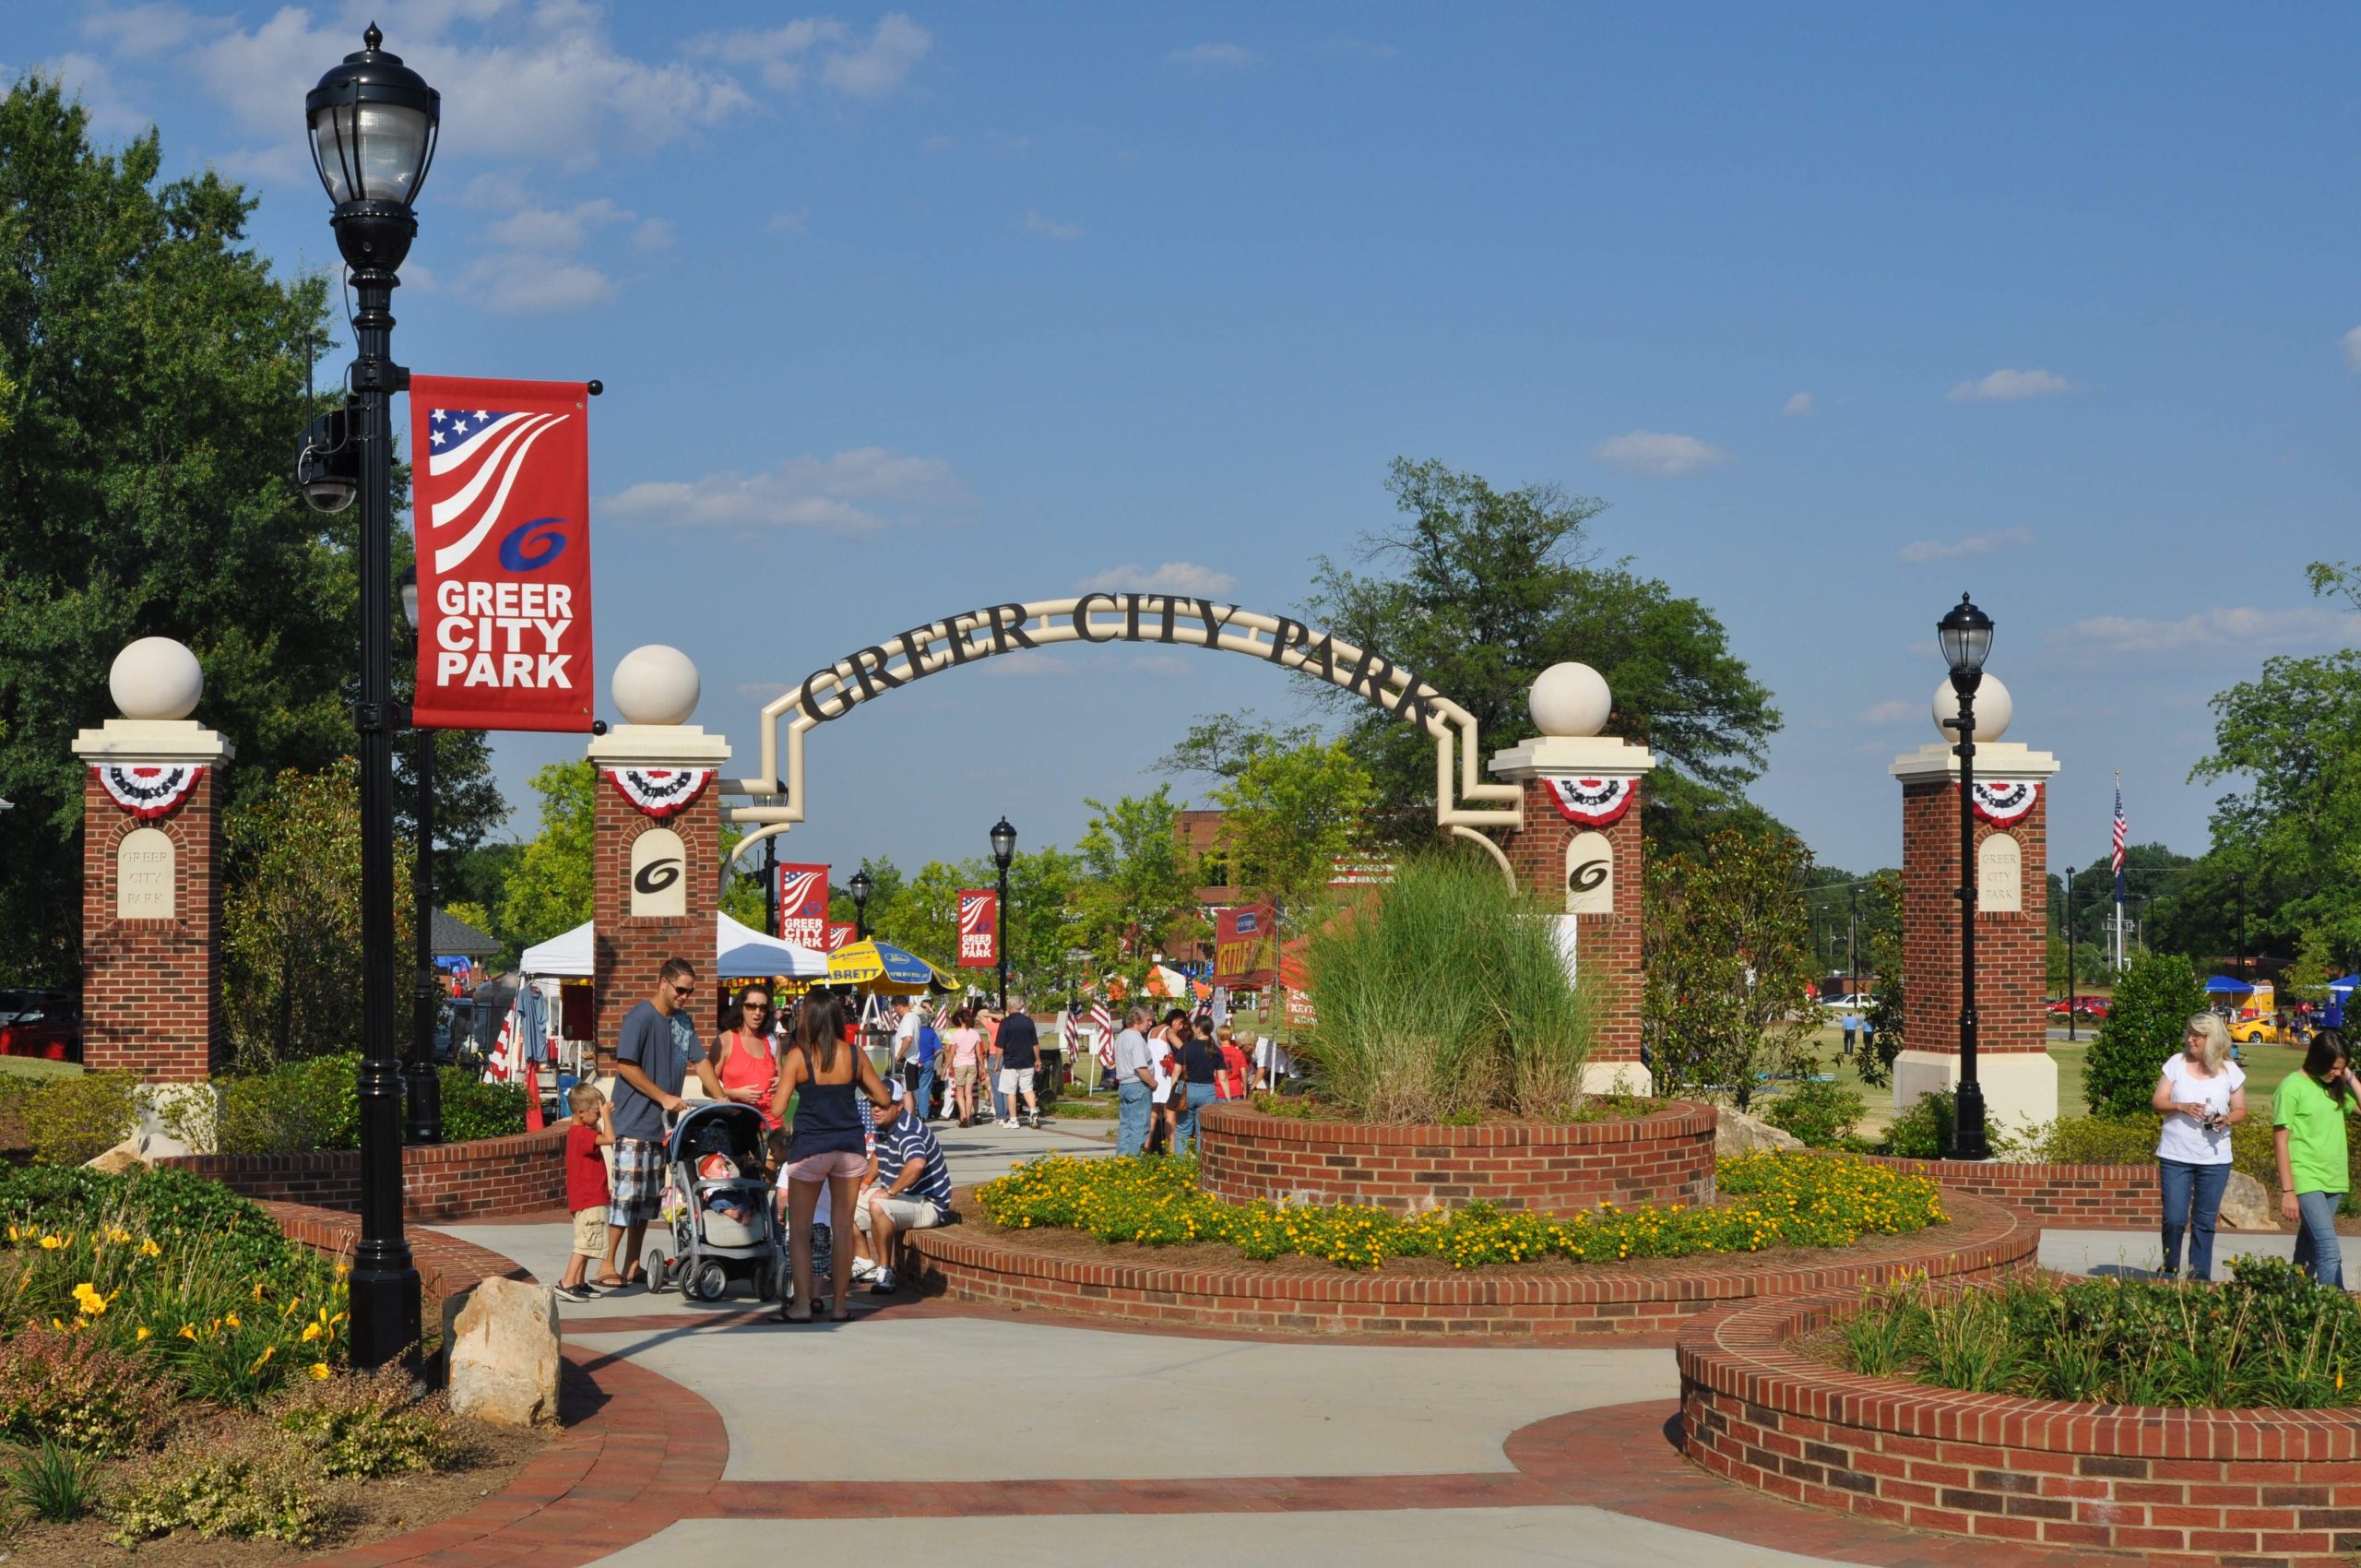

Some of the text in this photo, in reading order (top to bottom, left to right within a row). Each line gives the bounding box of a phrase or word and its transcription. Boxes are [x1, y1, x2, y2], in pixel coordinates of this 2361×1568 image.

[437, 580, 573, 618] GREER
[437, 616, 572, 653] CITY
[801, 592, 1445, 733] GREER CITY PARK
[437, 652, 573, 688] PARK
[123, 851, 169, 863] GREER
[1983, 853, 2018, 864] GREER
[129, 873, 162, 884] CITY
[1987, 872, 2011, 882] CITY
[127, 893, 163, 904] PARK
[1987, 889, 2013, 899] PARK
[784, 918, 823, 929] GREER
[784, 928, 823, 938] CITY
[962, 933, 991, 943] GREER
[962, 942, 991, 950] CITY
[962, 949, 991, 957] PARK
[1218, 942, 1250, 976] KETTLE
